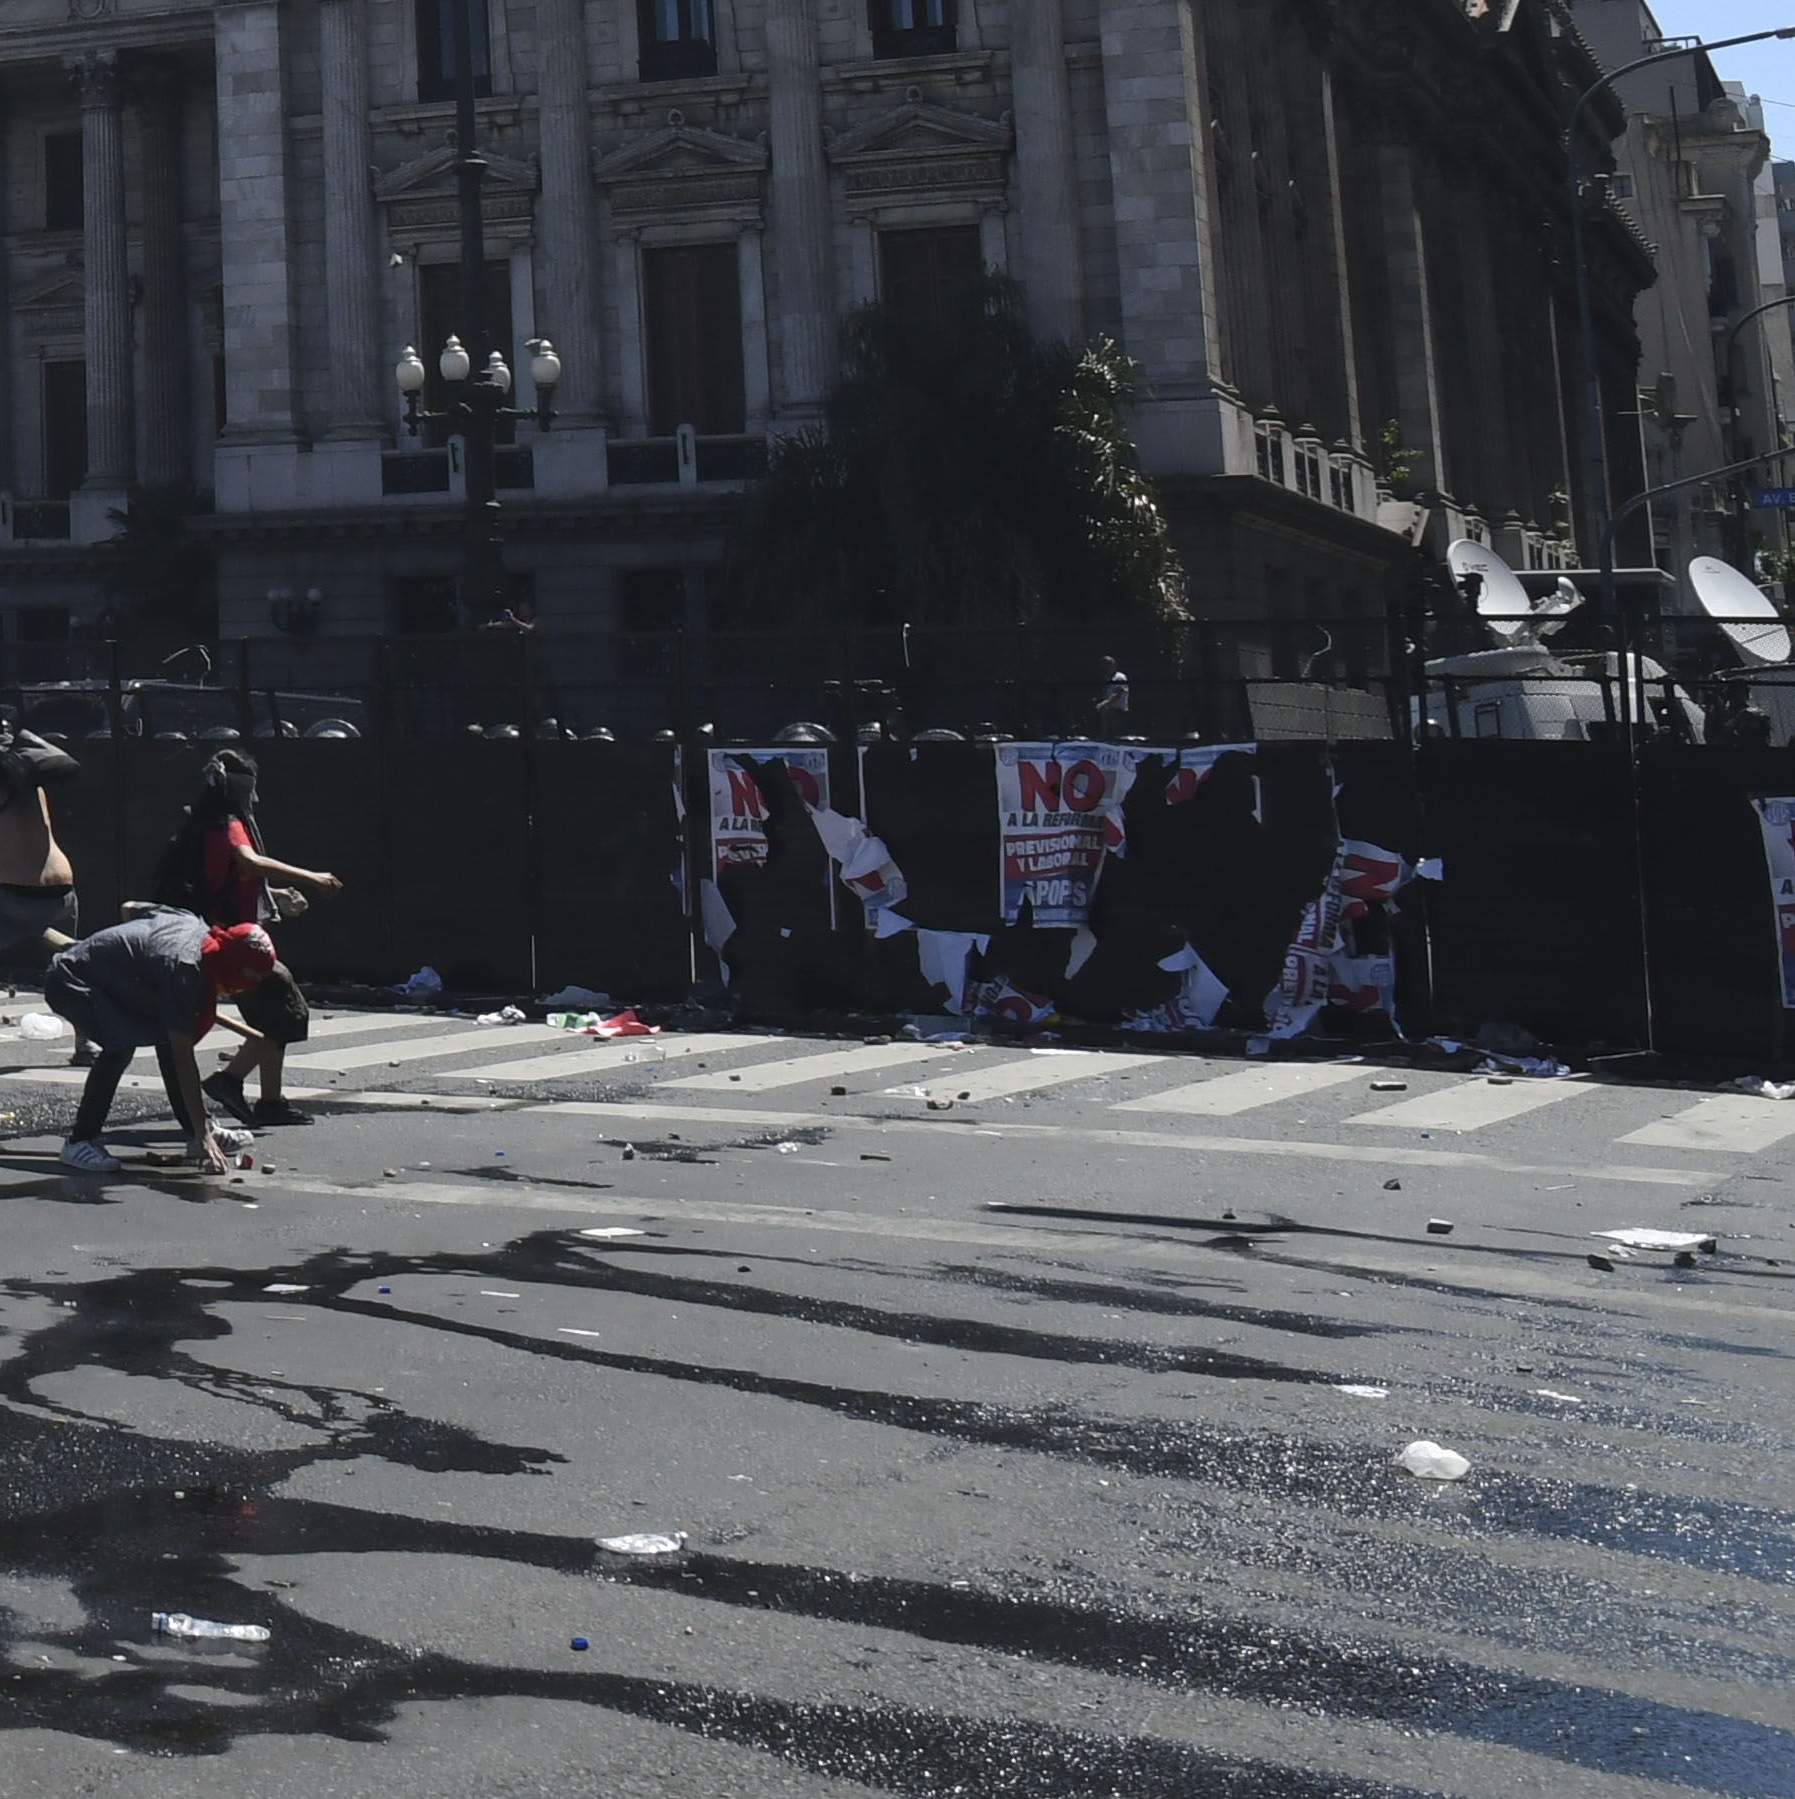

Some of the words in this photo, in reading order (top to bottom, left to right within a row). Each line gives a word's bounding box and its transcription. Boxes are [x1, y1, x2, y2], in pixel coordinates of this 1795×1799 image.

[1018, 760, 1106, 812] NO
[1007, 813, 1018, 827] A
[1022, 813, 1039, 827] LA
[1006, 834, 1101, 857] PREVISIONAL
[1016, 858, 1026, 872] Y
[1028, 852, 1089, 872] LABORAL
